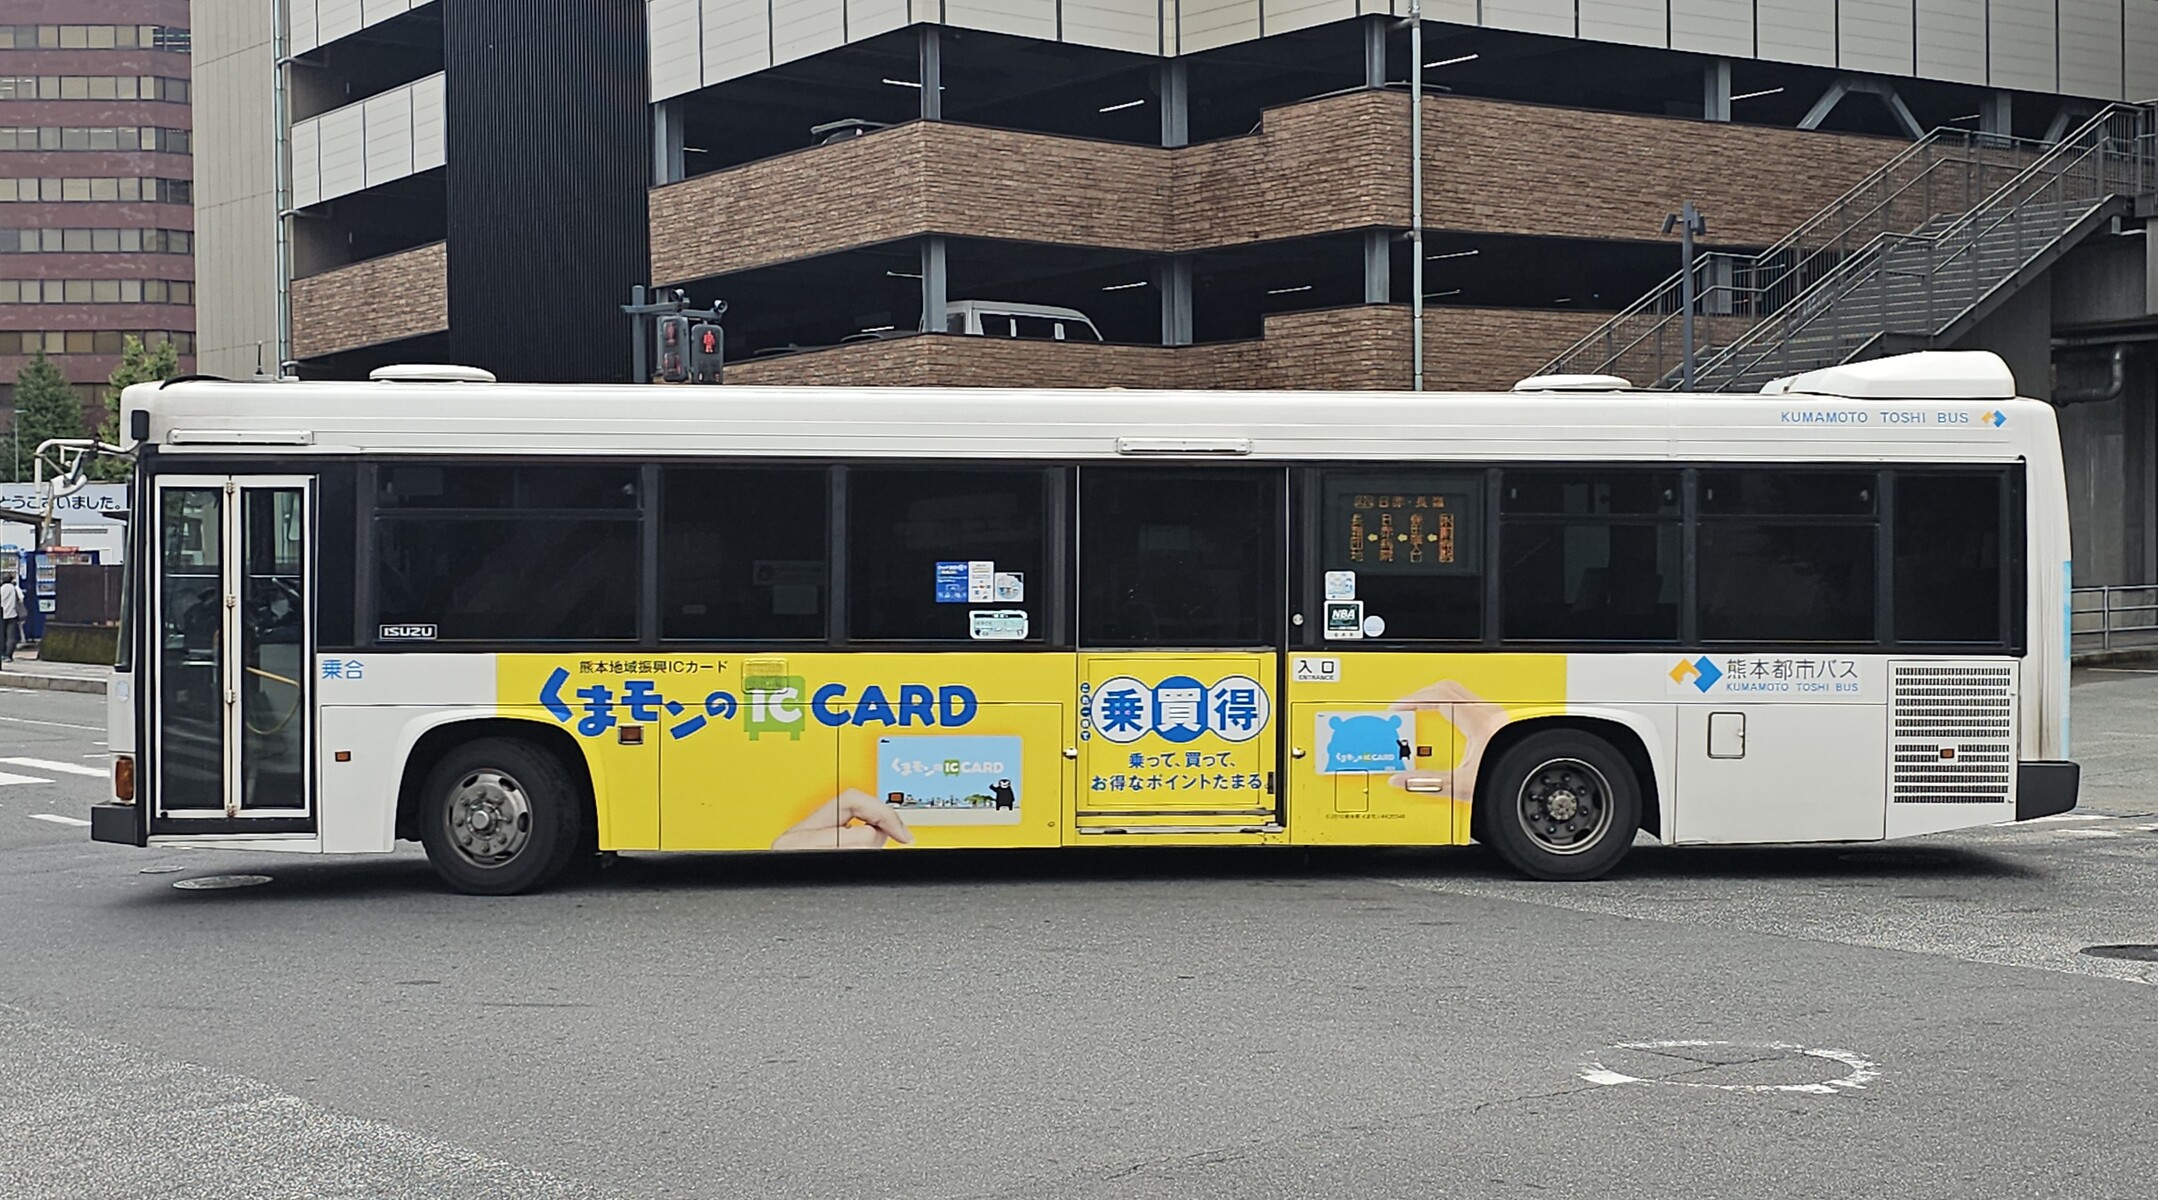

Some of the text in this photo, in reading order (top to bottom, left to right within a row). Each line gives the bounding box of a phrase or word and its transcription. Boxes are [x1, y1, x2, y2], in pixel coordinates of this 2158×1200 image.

[1781, 411, 1969, 424] KUMAMOTO TOSHI BUS
[384, 627, 432, 636] ISUZU
[322, 659, 364, 679] 乗合
[579, 660, 728, 673] 熊本地域振興ICカード
[1727, 659, 1858, 680] 熊本都市バス
[1726, 683, 1859, 691] KUMAMOTO TOSHI BUS
[812, 684, 978, 727] CARD
